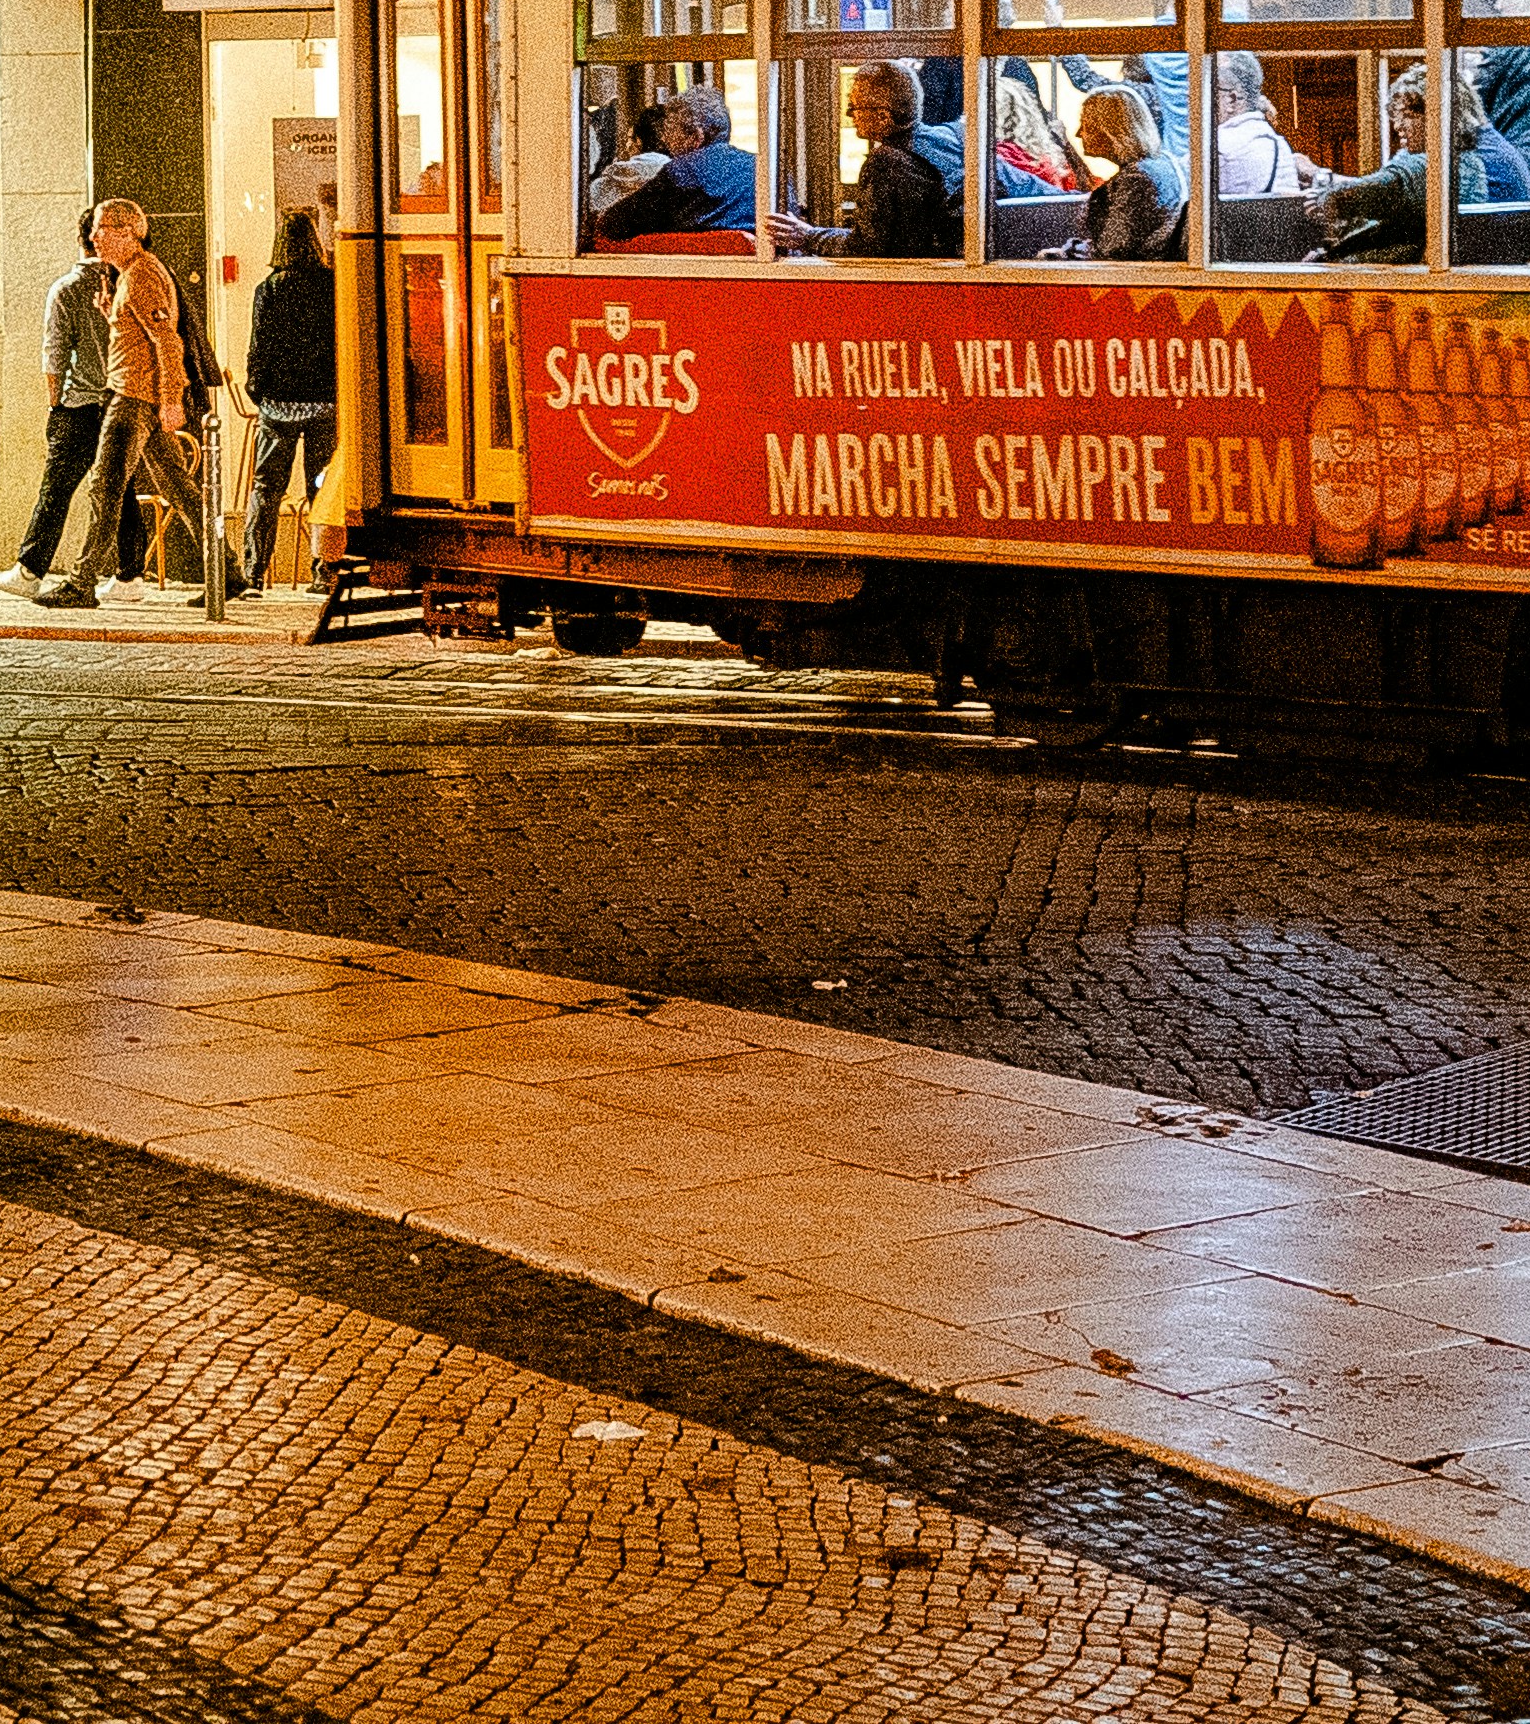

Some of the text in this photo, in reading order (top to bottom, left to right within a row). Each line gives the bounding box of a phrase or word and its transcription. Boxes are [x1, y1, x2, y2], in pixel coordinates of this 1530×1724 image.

[545, 346, 700, 415] SAGRES
[790, 337, 1266, 410] NA RUELA, VIELA OU CALÇADA,
[765, 433, 1298, 526] MARCHA SEMPRE BEM
[1466, 522, 1499, 553] SÊ
